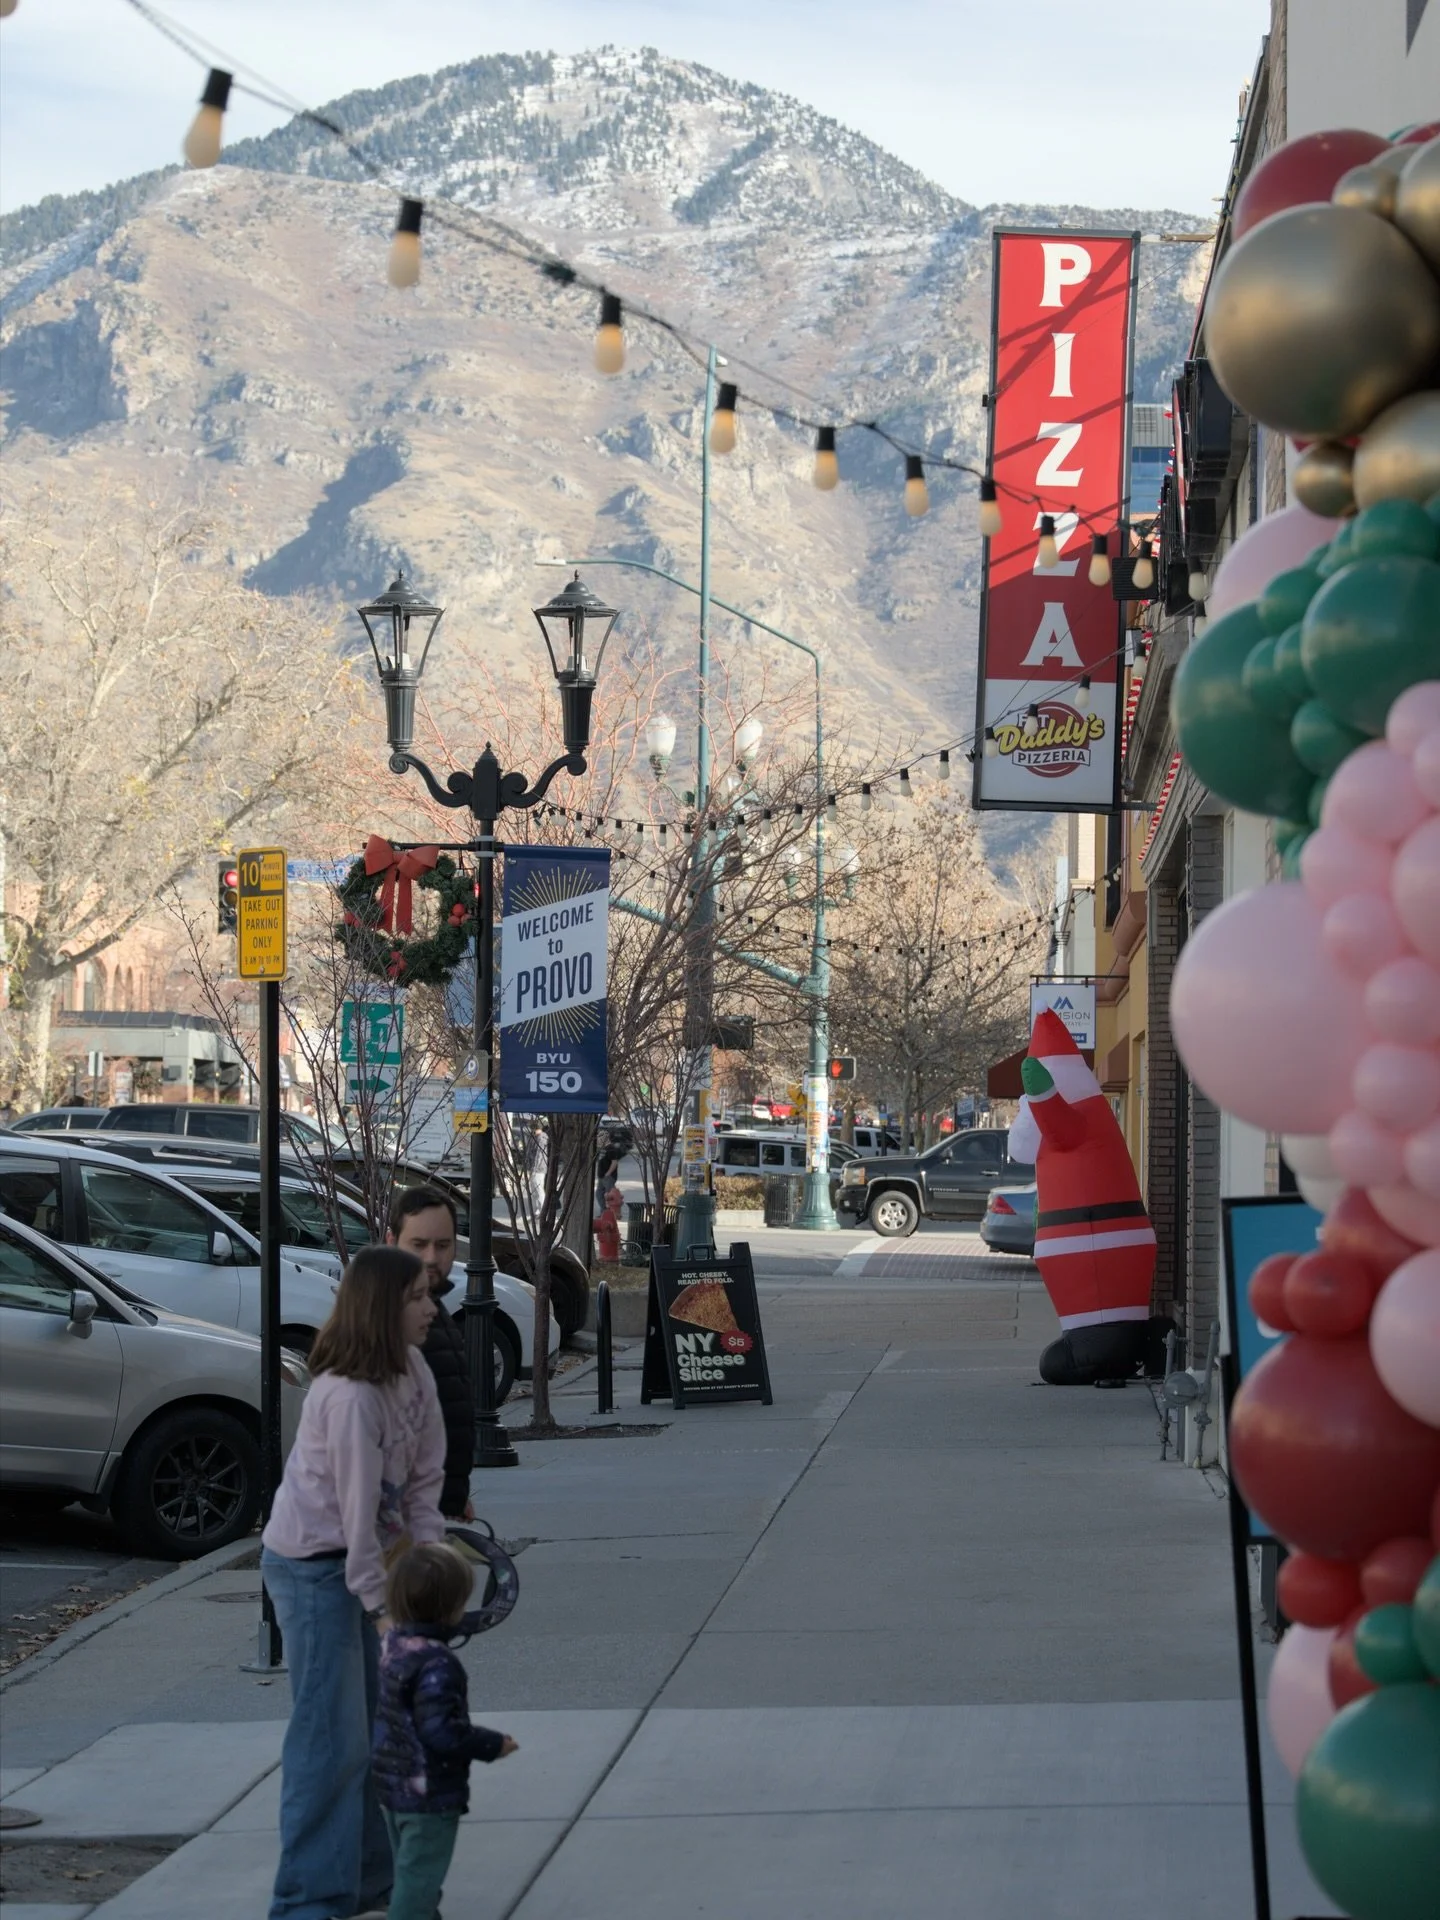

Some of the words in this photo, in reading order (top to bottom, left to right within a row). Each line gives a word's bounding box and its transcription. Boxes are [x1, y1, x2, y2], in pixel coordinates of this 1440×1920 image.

[1019, 242, 1091, 667] PIZZA
[1017, 713, 1049, 729] FT
[994, 712, 1105, 755] Daddy's
[1018, 750, 1086, 764] PIZZERIA
[241, 861, 259, 887] 10
[261, 873, 281, 881] PARKING
[244, 900, 262, 912] TAKE
[265, 899, 280, 911] OUT
[246, 917, 278, 930] PARKING
[518, 902, 594, 942] WELCOME
[252, 936, 272, 949] ONLY
[547, 937, 563, 956] to
[516, 951, 593, 1014] PROVO
[536, 1052, 571, 1064] BYU
[525, 1071, 583, 1094] 150
[674, 1332, 715, 1353] NY
[728, 1336, 745, 1347] $5
[677, 1353, 746, 1368] Cheese
[679, 1367, 725, 1382] Slice
